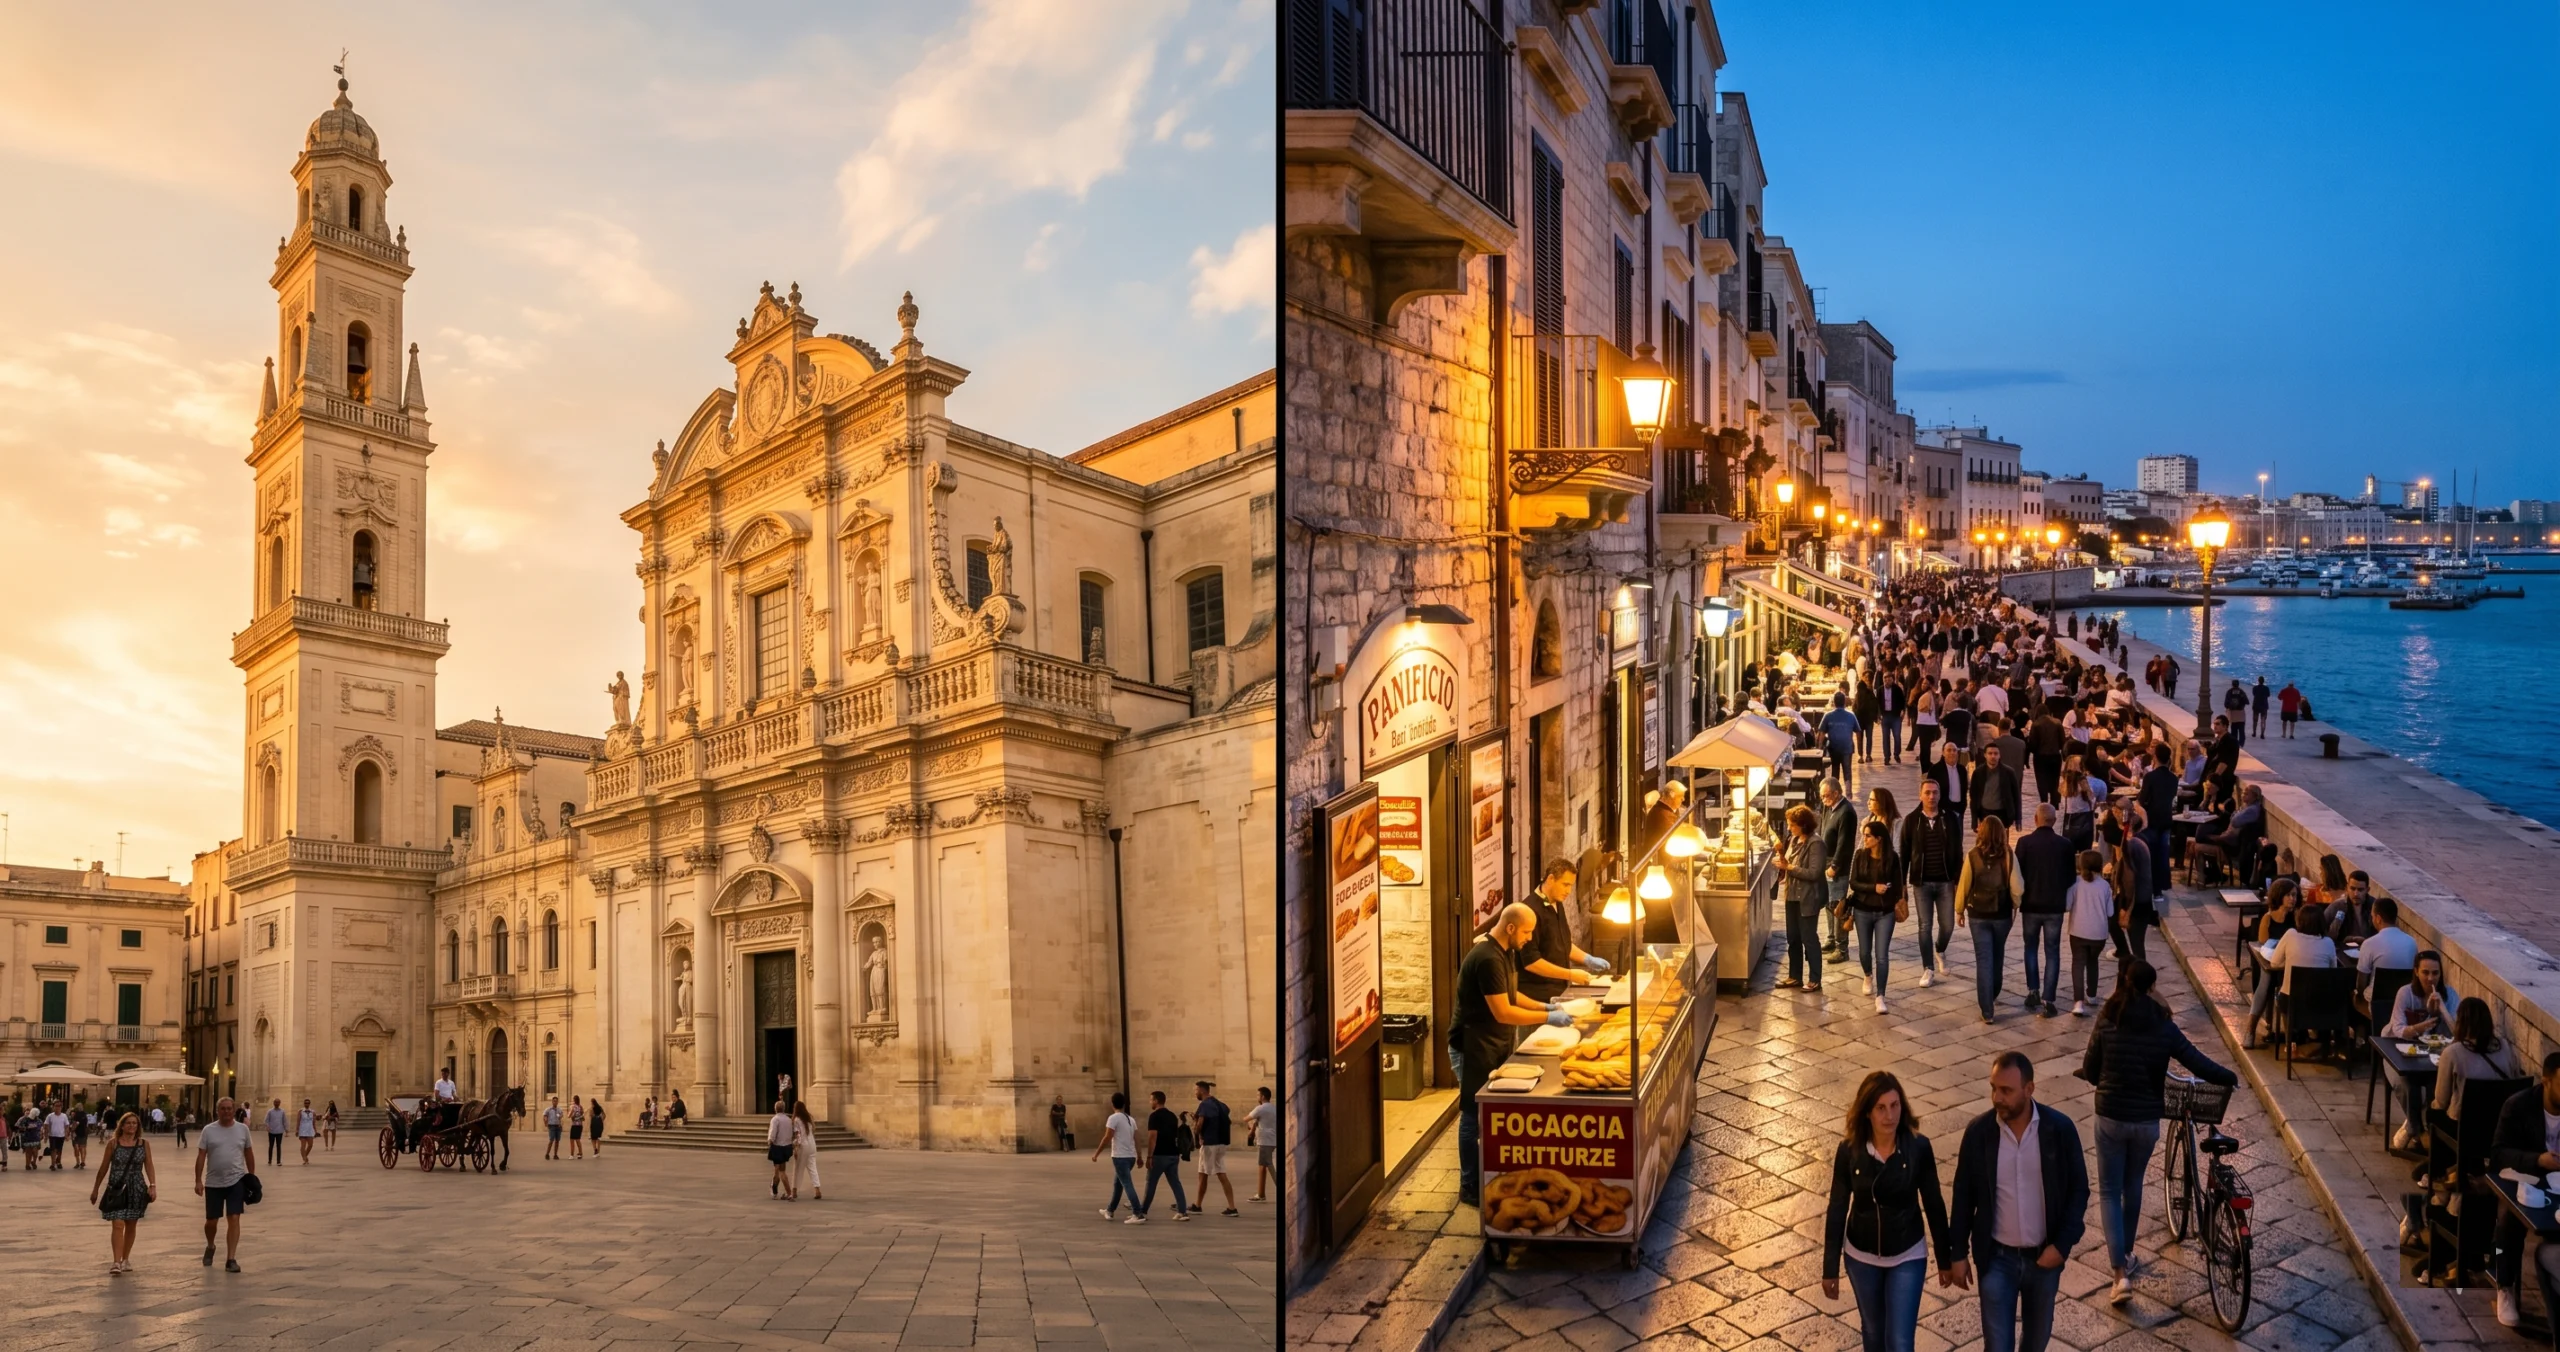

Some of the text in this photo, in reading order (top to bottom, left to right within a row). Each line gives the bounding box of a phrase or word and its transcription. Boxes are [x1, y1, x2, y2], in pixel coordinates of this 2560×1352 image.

[1367, 663, 1454, 741] PANIFICIO
[1490, 1112, 1625, 1140] FOCACCIA
[1499, 1145, 1616, 1167] FRITTURZE
